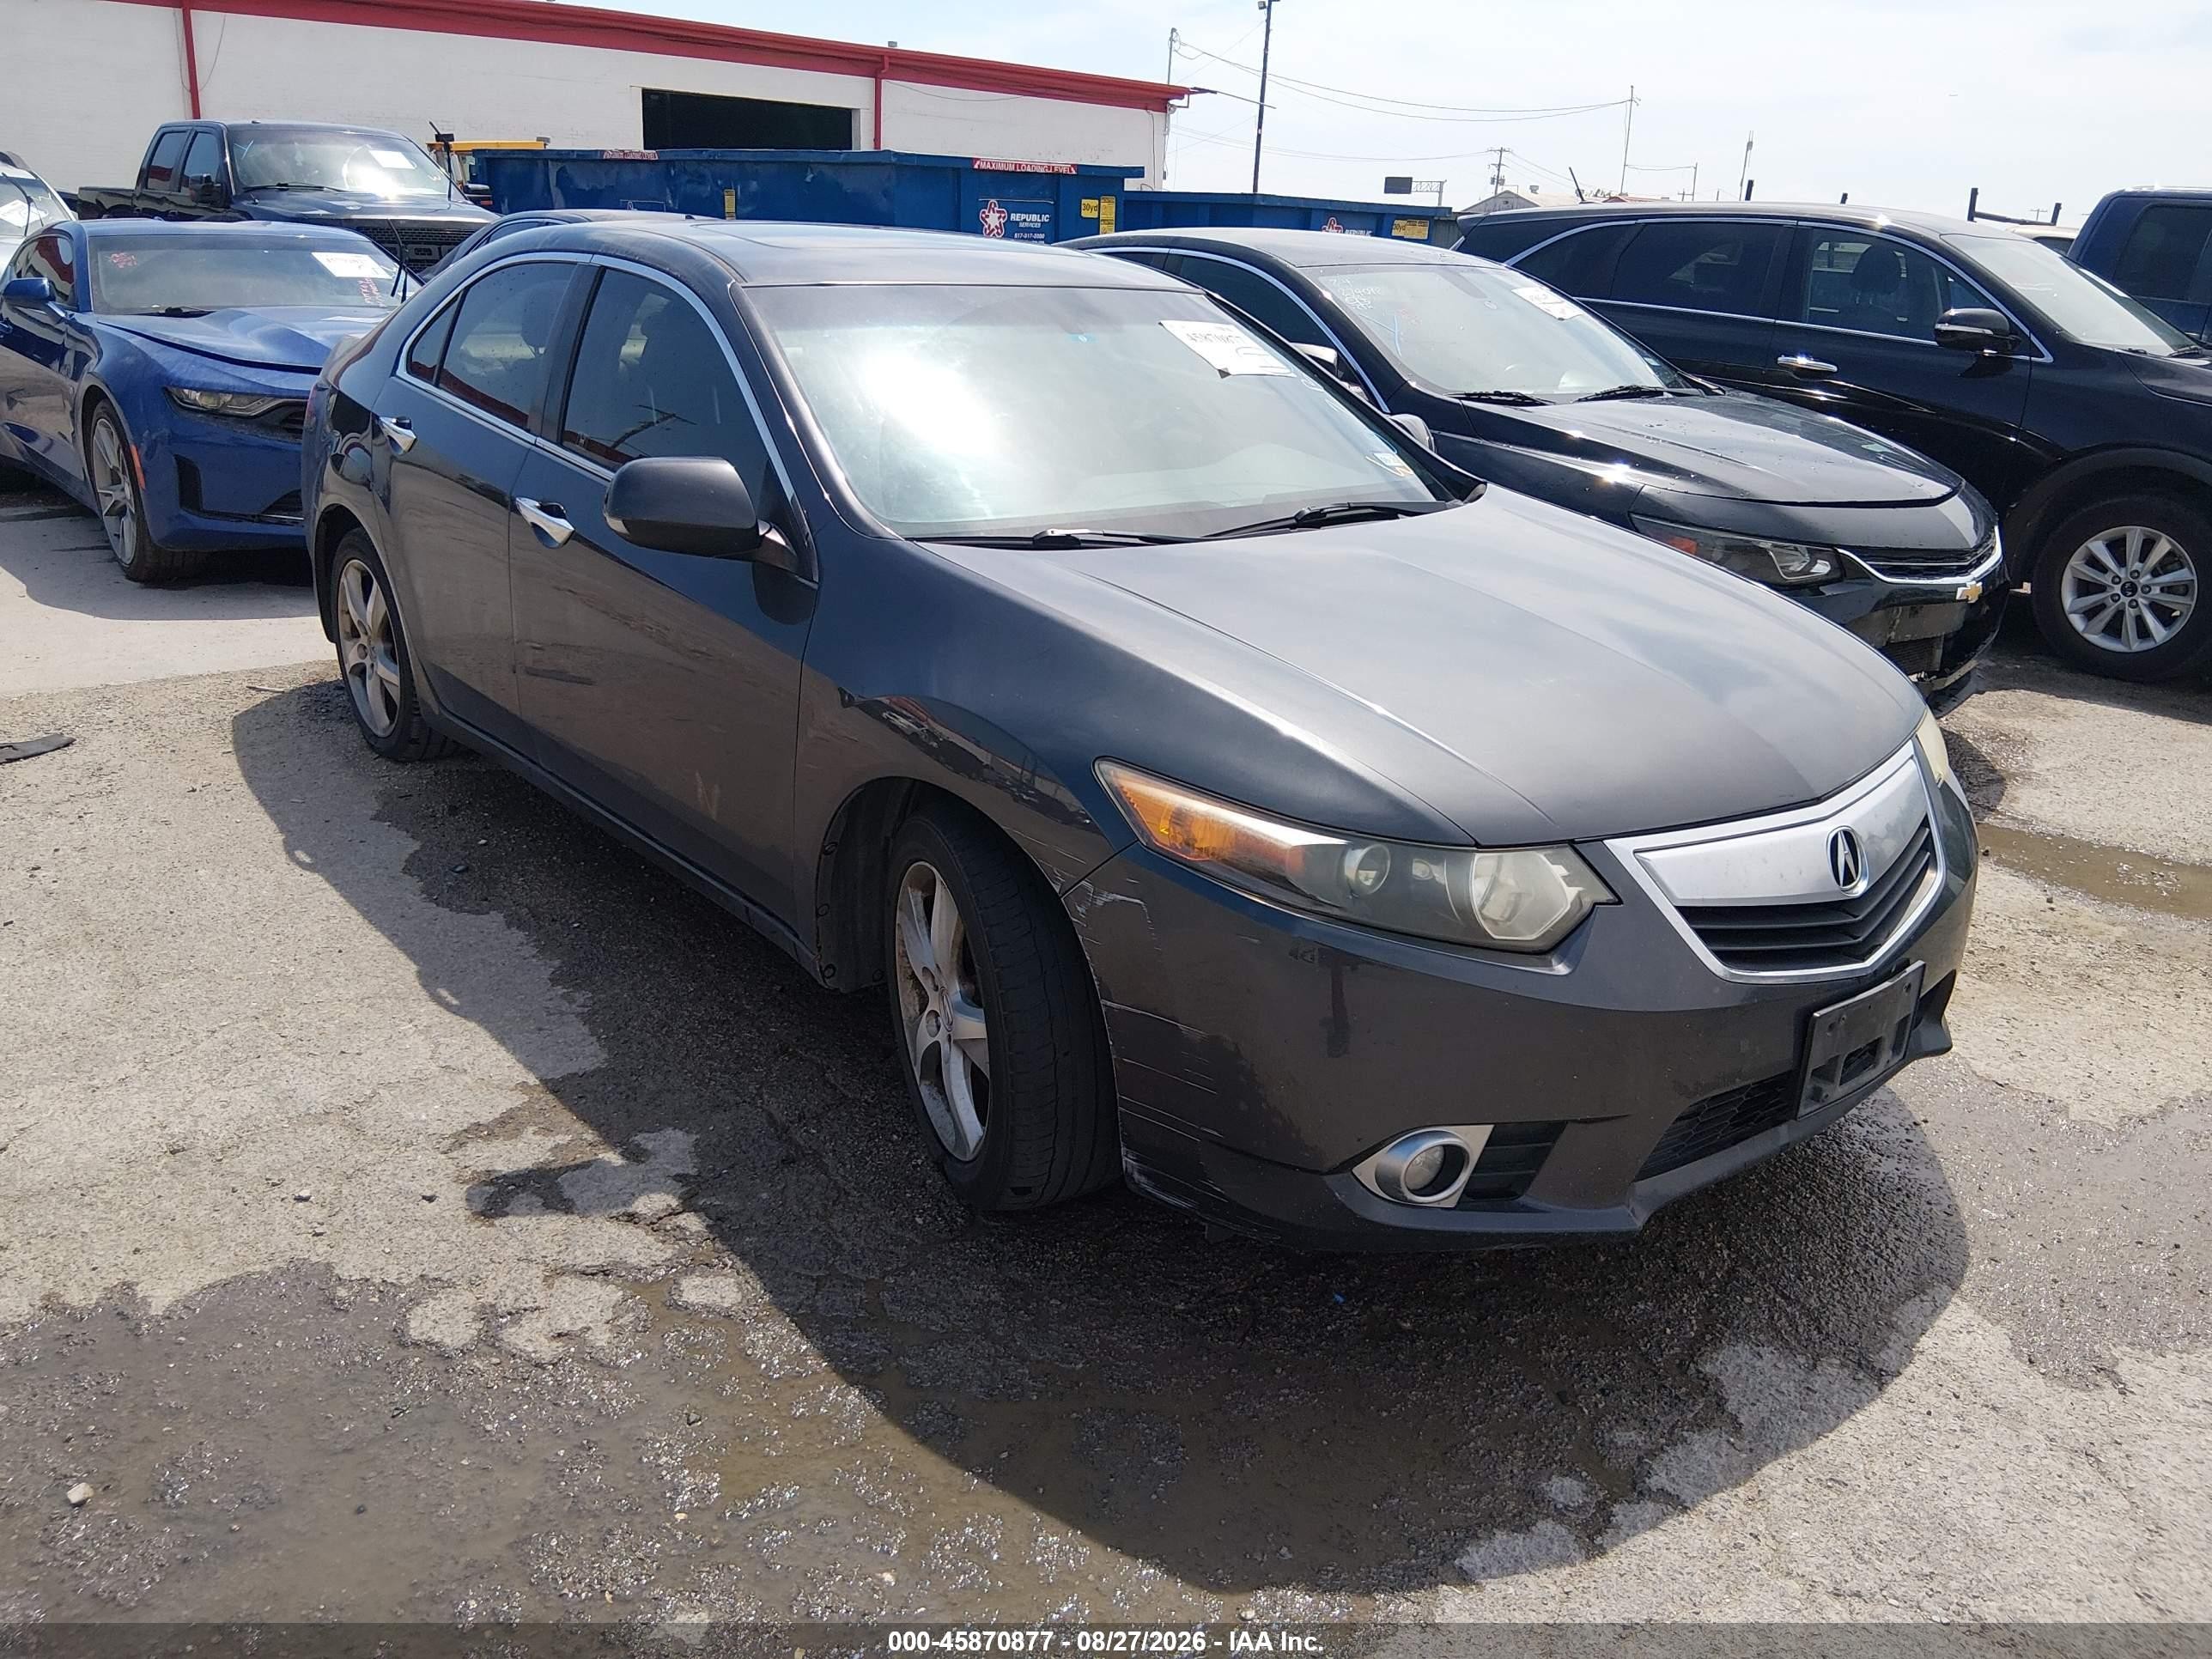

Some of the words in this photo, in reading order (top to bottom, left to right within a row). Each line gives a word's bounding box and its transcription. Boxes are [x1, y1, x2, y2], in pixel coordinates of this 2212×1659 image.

[980, 161, 1014, 171] MAXIMUM
[1016, 164, 1048, 173] LOADING
[1050, 166, 1071, 174] LEVEL
[1082, 203, 1098, 213] 30yd
[1010, 213, 1050, 222] REPUBLIC
